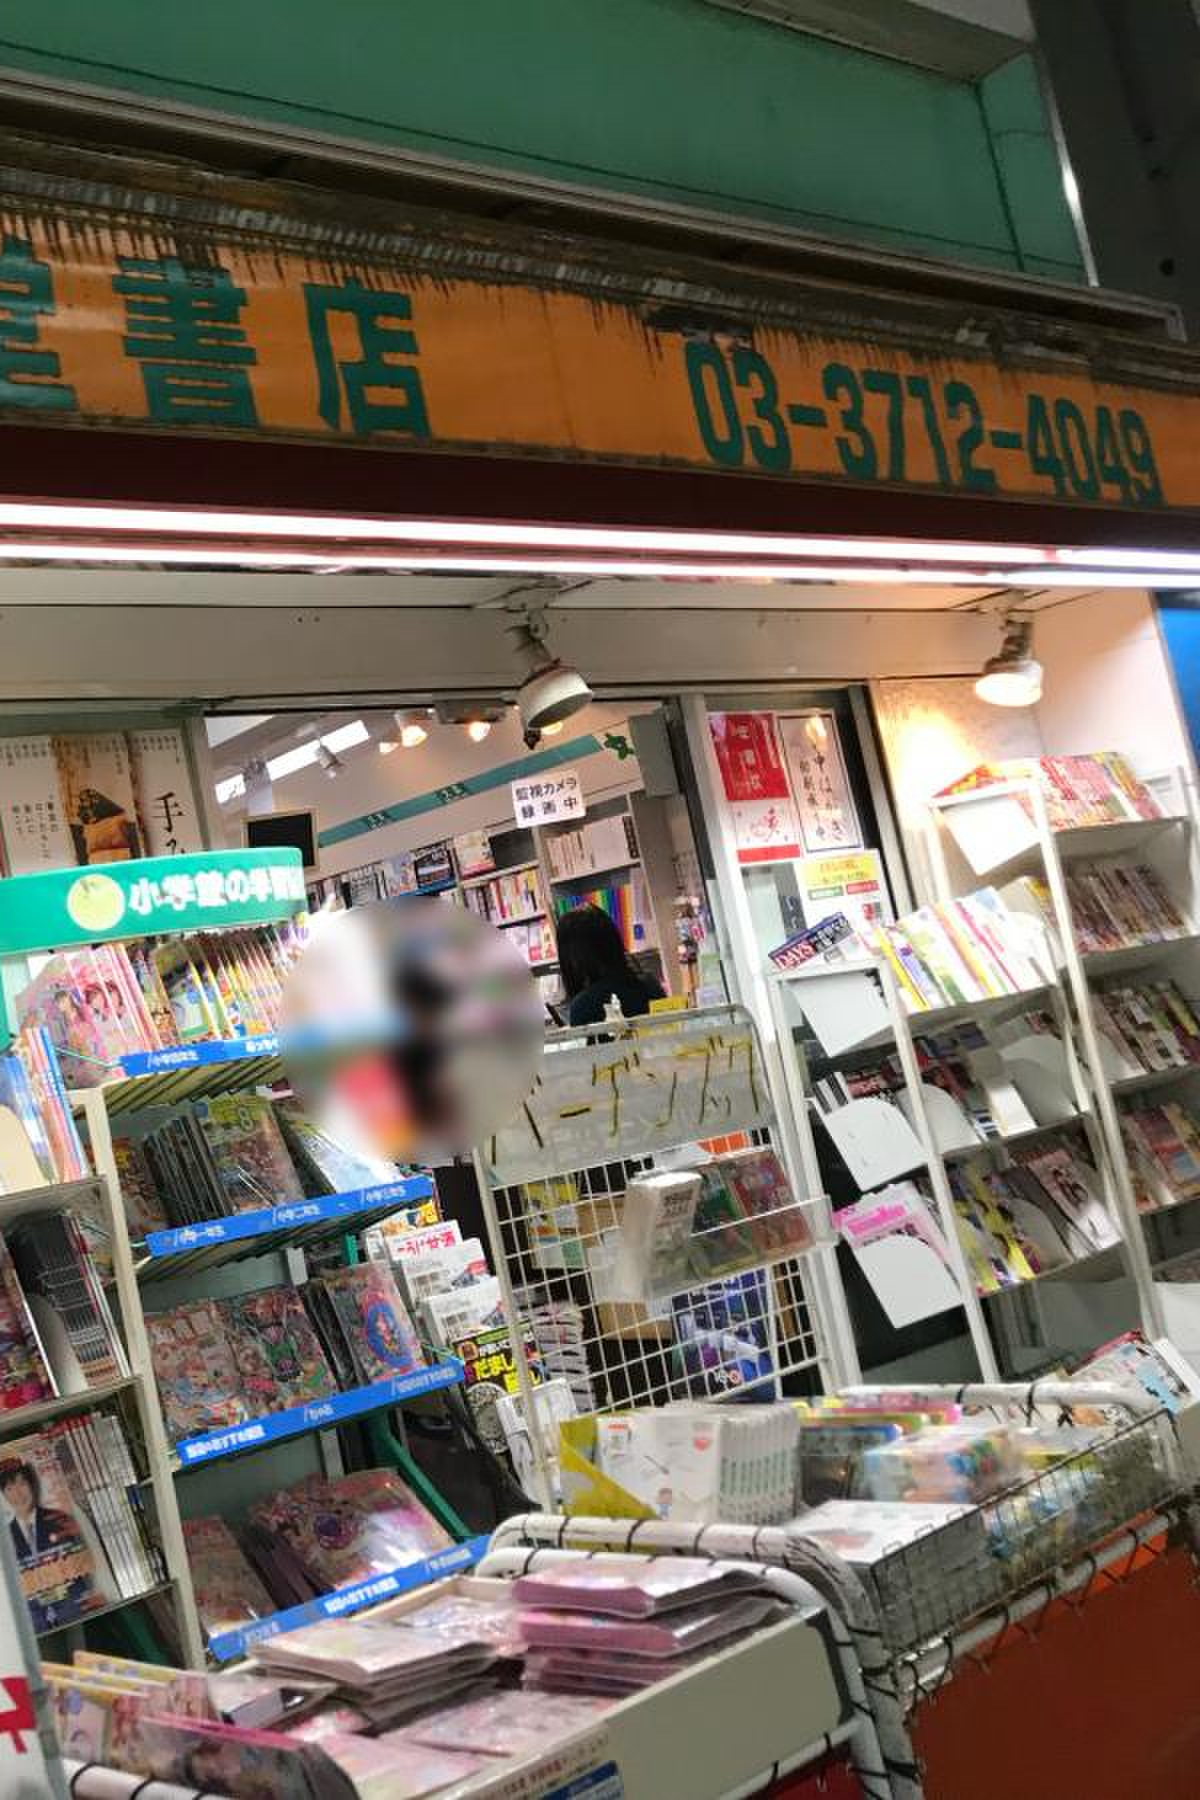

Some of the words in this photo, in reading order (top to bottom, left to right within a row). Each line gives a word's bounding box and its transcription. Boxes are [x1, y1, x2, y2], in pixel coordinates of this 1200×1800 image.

[684, 341, 1167, 508] 03-3712-4049
[515, 777, 578, 801] 監視カメラ
